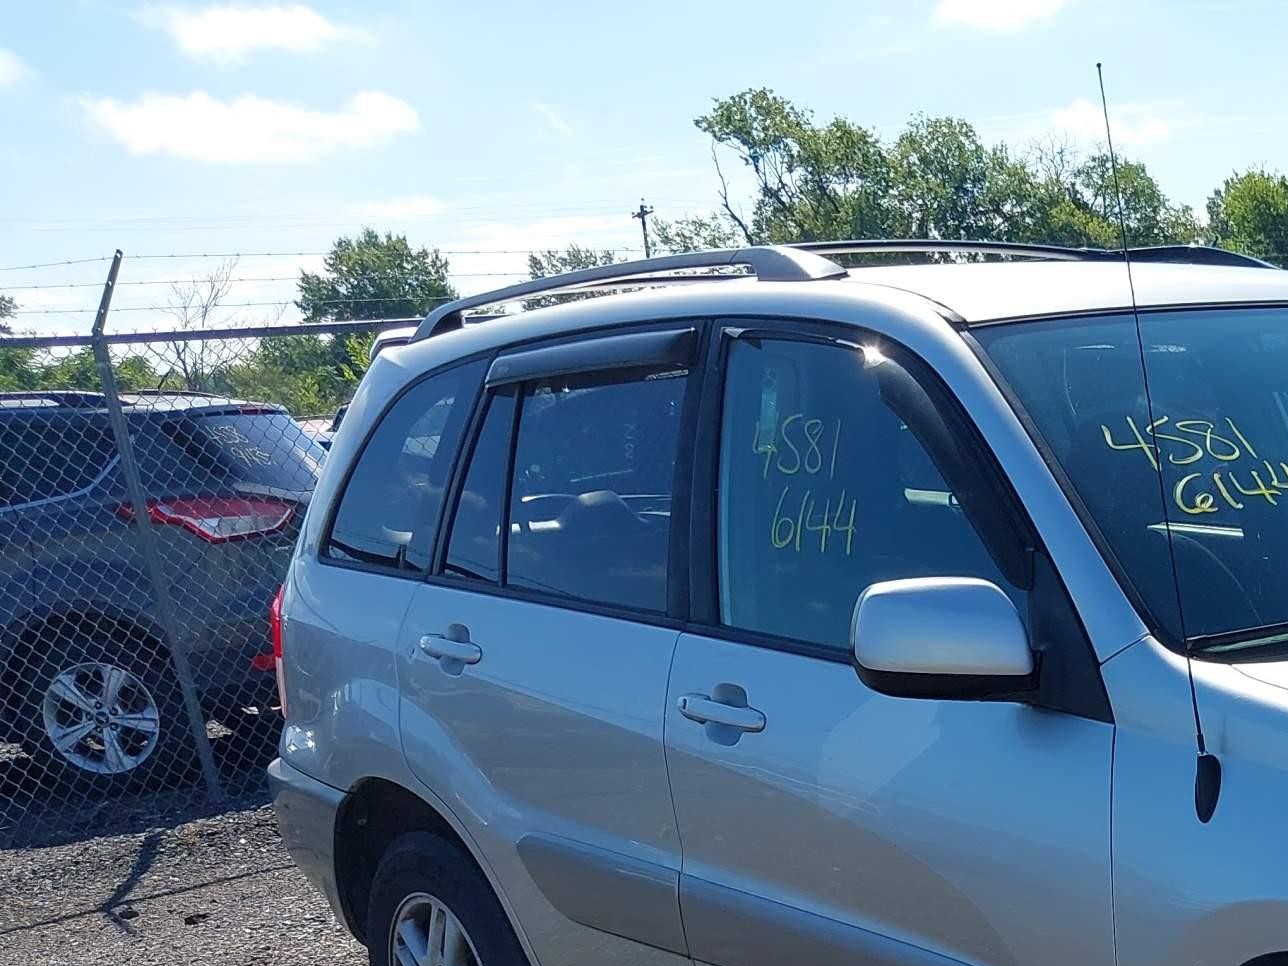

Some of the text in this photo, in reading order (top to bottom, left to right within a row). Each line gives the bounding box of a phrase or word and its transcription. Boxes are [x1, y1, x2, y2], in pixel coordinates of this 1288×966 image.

[753, 414, 841, 480] 4581
[1101, 415, 1258, 472] 4581
[771, 486, 857, 555] 6144
